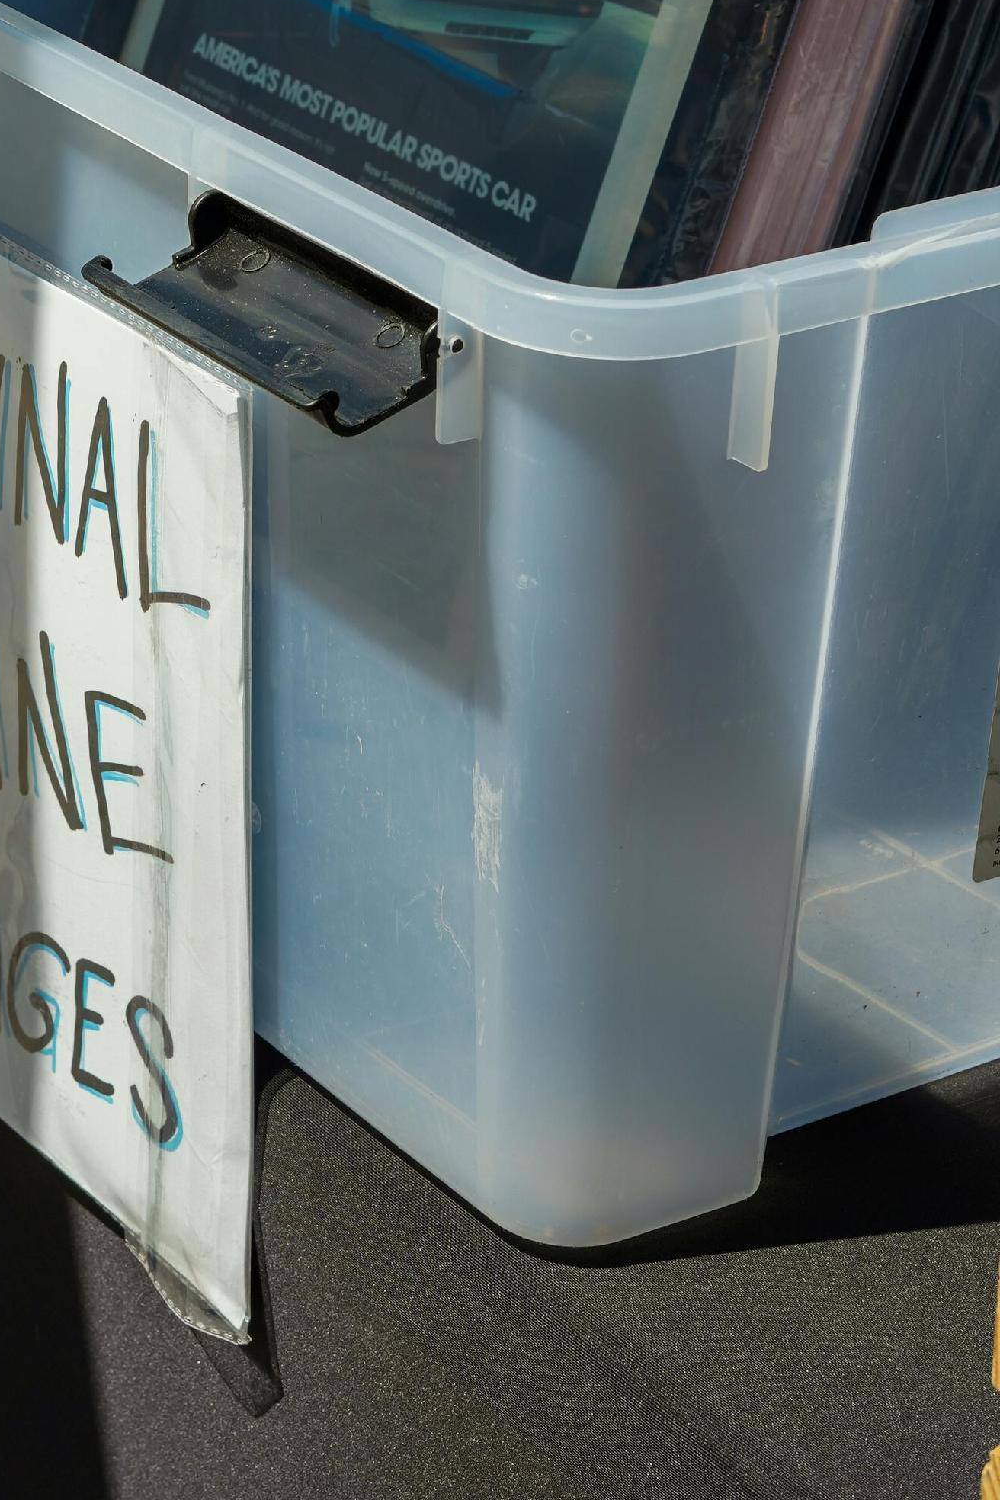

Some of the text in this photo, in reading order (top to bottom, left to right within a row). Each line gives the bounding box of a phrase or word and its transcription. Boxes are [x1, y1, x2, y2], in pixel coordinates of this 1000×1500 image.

[192, 32, 281, 94] AMERICA'S
[279, 74, 335, 119] MOST
[329, 100, 419, 163] POPULAR
[416, 142, 493, 199] SPORTS
[491, 180, 537, 223] CAR
